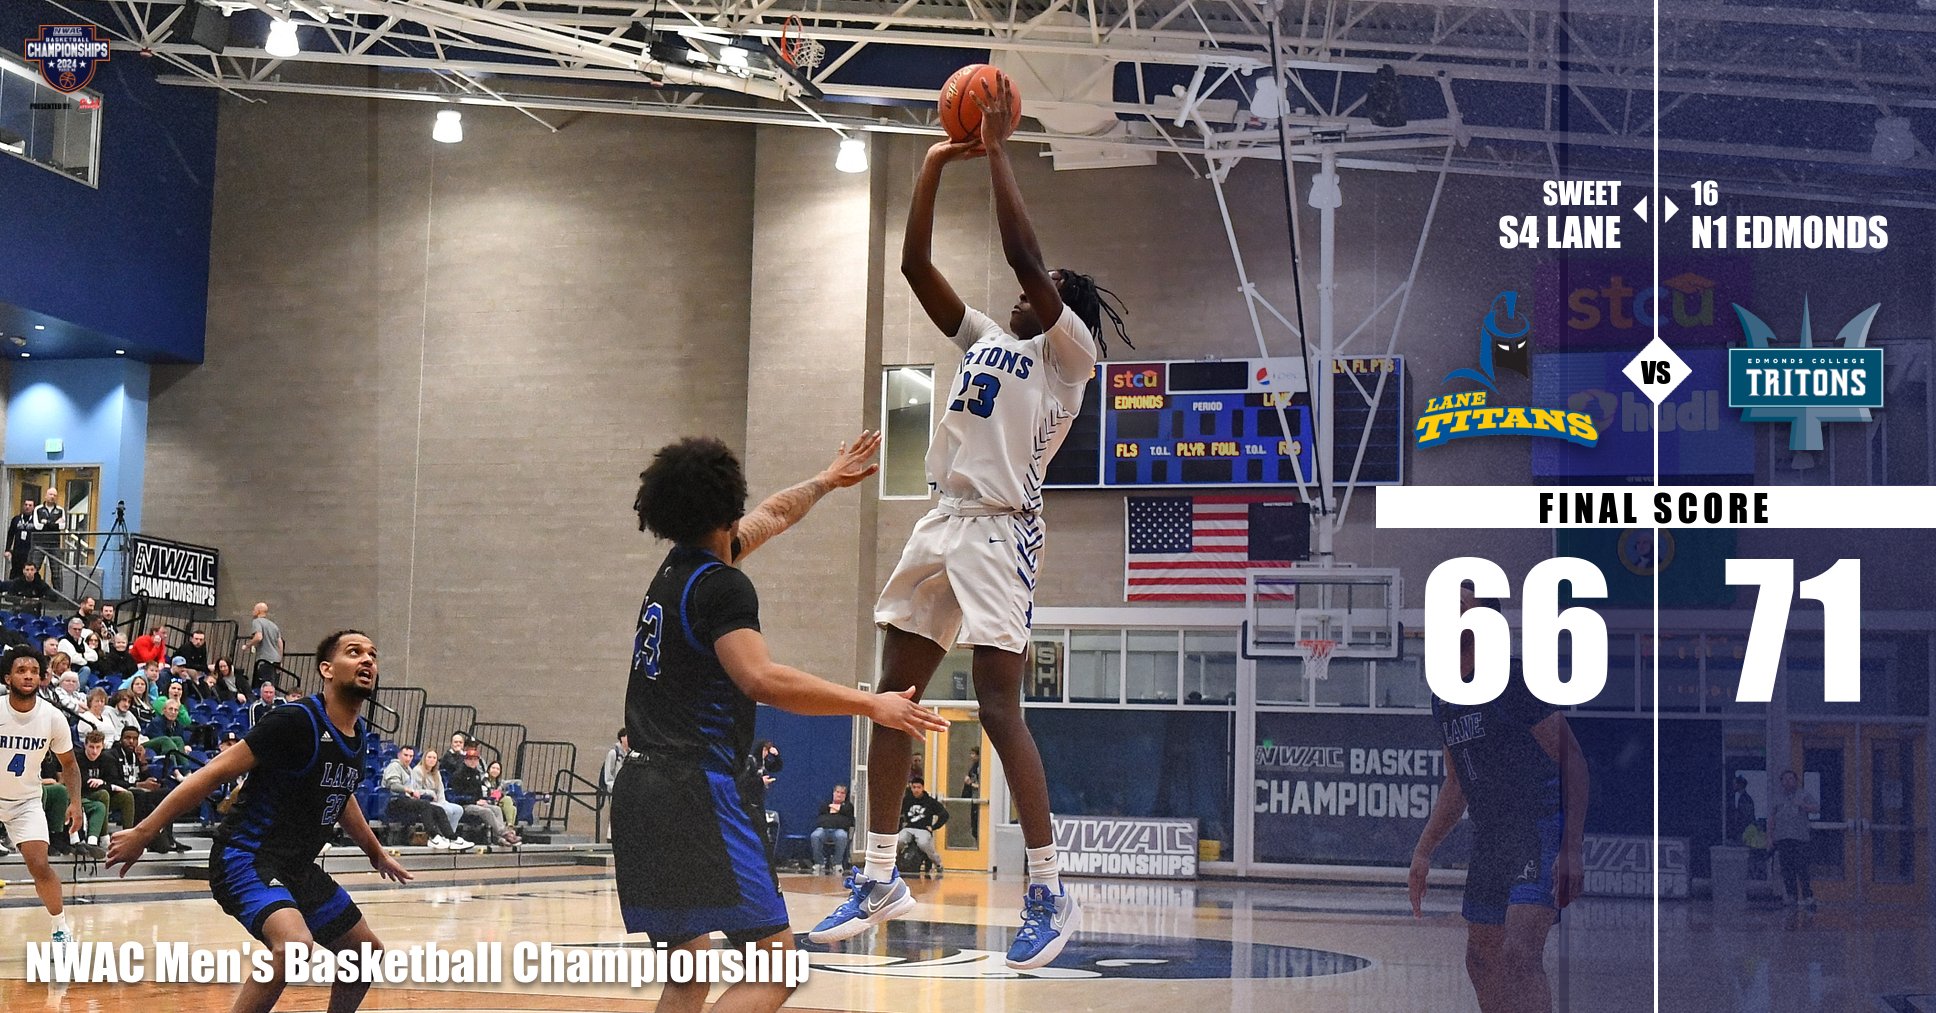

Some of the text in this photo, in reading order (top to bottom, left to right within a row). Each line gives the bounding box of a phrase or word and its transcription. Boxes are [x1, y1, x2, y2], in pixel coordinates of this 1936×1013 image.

[1567, 274, 1715, 330] stcu
[1113, 370, 1158, 388] stcu
[949, 370, 1002, 419] 23
[1114, 395, 1163, 410] EDMONDS
[1192, 401, 1223, 412] PERIOD
[1621, 390, 1719, 432] hudl
[1116, 443, 1138, 458] FLS
[1176, 442, 1205, 457] PLYR
[1211, 442, 1239, 457] FOUL
[134, 542, 214, 585] NWAC
[131, 574, 215, 607] CHAMPIONSHIPS
[0, 735, 47, 751] RITONS
[1443, 712, 1485, 747] LANE
[7, 753, 26, 777] 4
[1255, 746, 1447, 776] NWAC BASKET
[1056, 851, 1196, 876] AMPIONSHIPS
